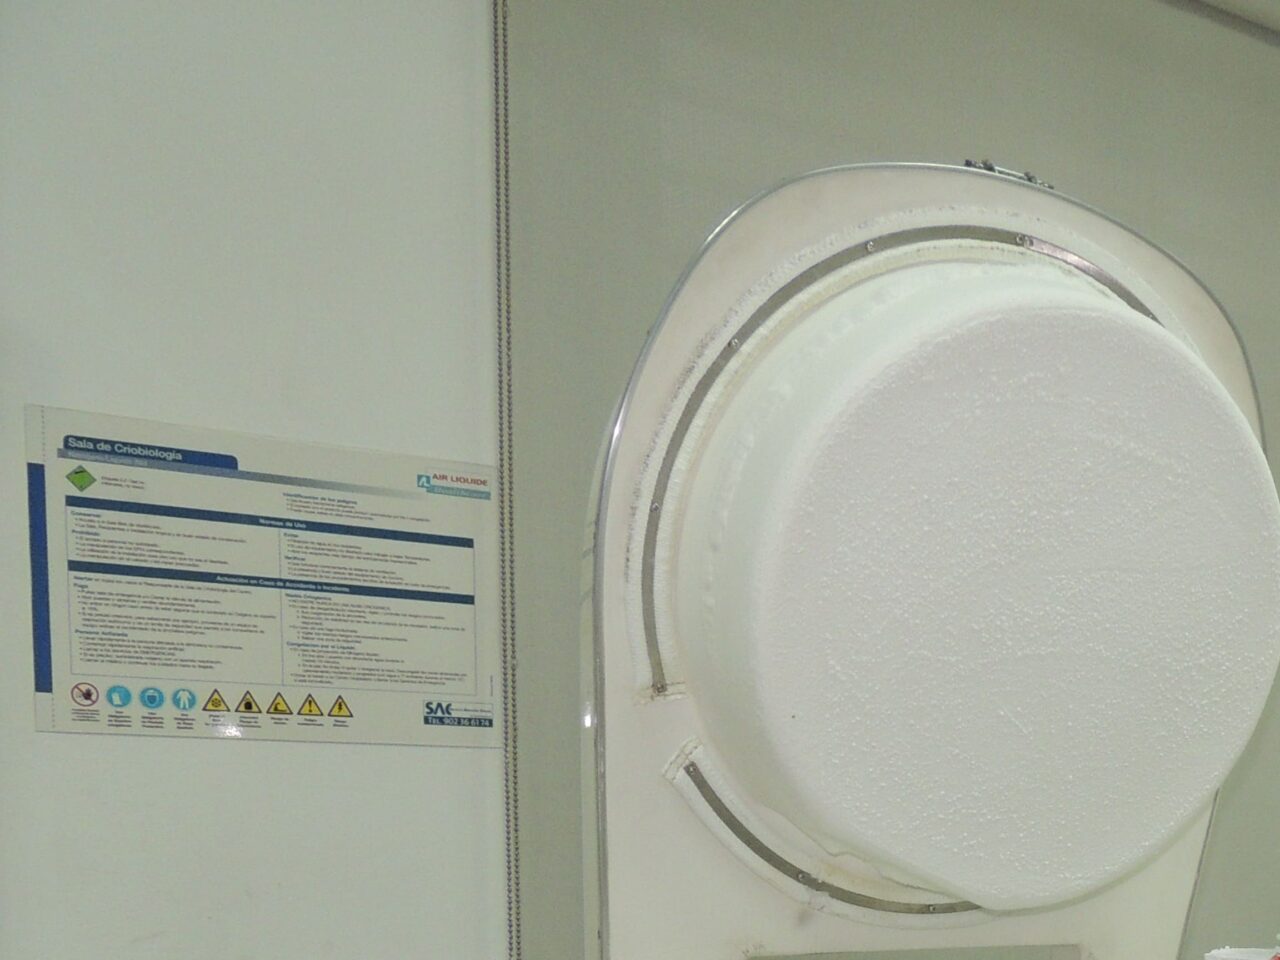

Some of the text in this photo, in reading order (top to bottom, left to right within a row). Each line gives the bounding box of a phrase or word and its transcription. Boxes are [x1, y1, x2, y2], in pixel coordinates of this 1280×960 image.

[68, 437, 94, 450] Sala
[97, 442, 112, 452] de
[432, 473, 489, 487] AIR LIQUIDE
